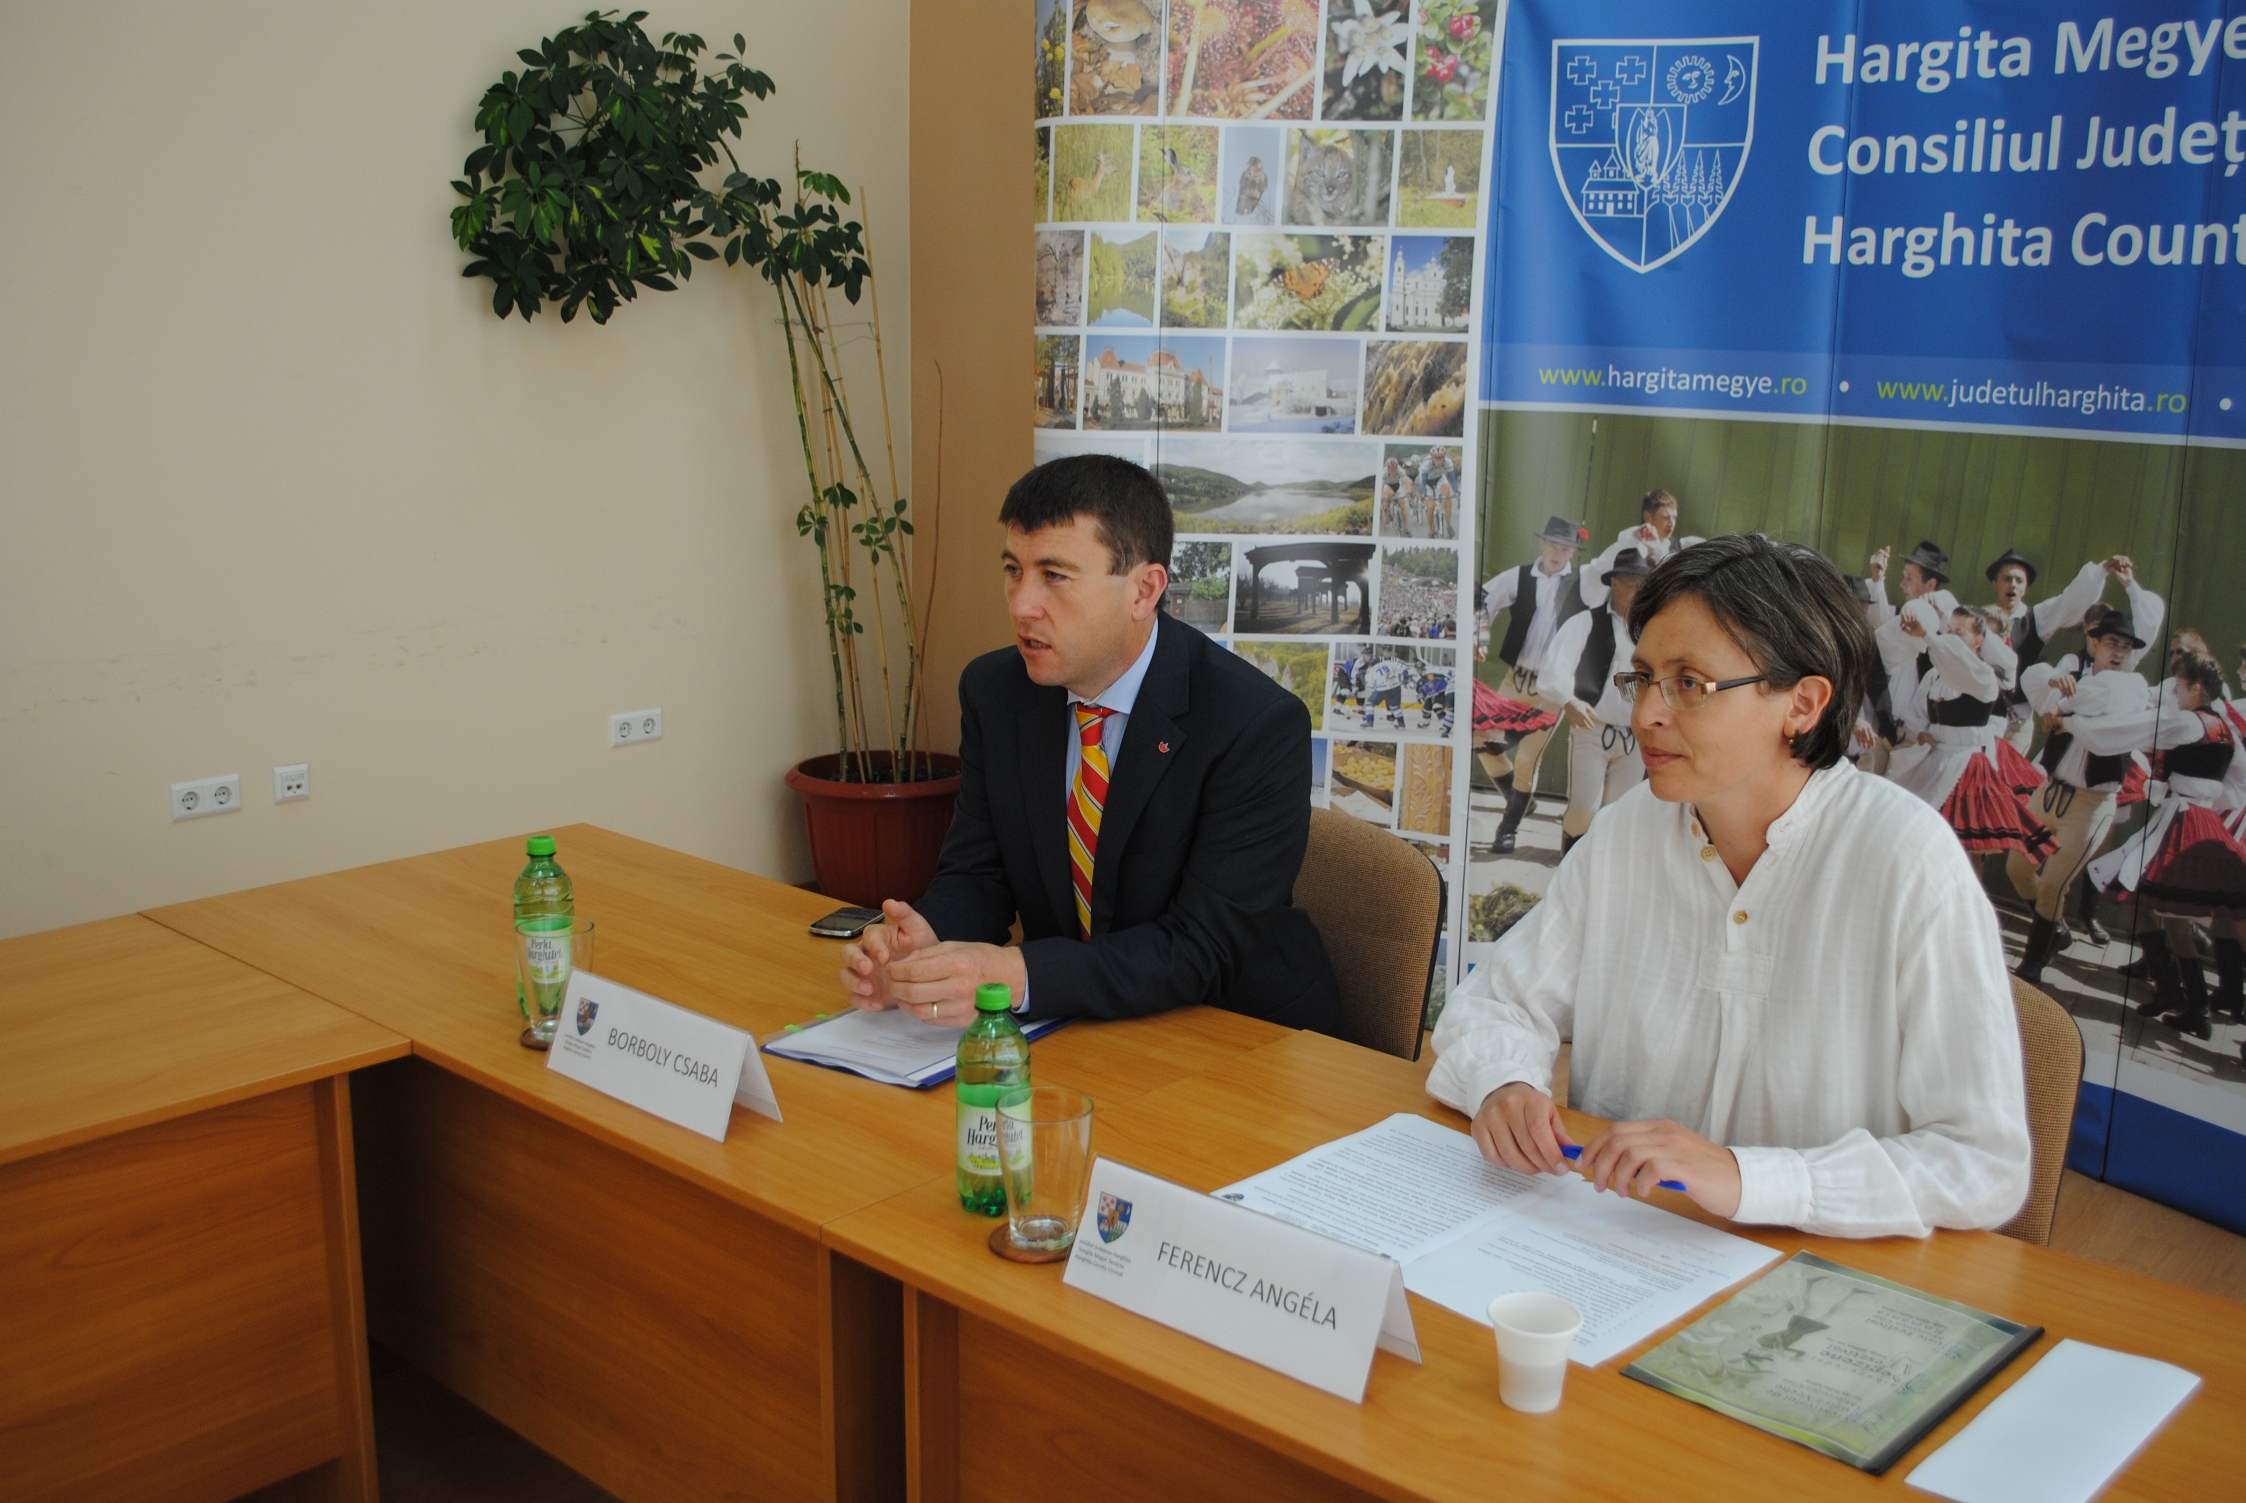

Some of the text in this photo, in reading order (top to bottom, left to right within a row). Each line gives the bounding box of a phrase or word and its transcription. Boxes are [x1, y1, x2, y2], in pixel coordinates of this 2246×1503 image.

[1815, 15, 2246, 94] Hargita Megye
[1808, 115, 2062, 175] Consiliul
[1803, 211, 2053, 278] Harghita
[1538, 363, 1807, 398] www.hargitamegye.ro
[1876, 378, 2188, 415] www.judetulharghita.ro
[608, 1027, 673, 1067] BORBOLY
[673, 1054, 718, 1088] CSABA
[1157, 1241, 1336, 1330] FERENCZ ANGÉLA
